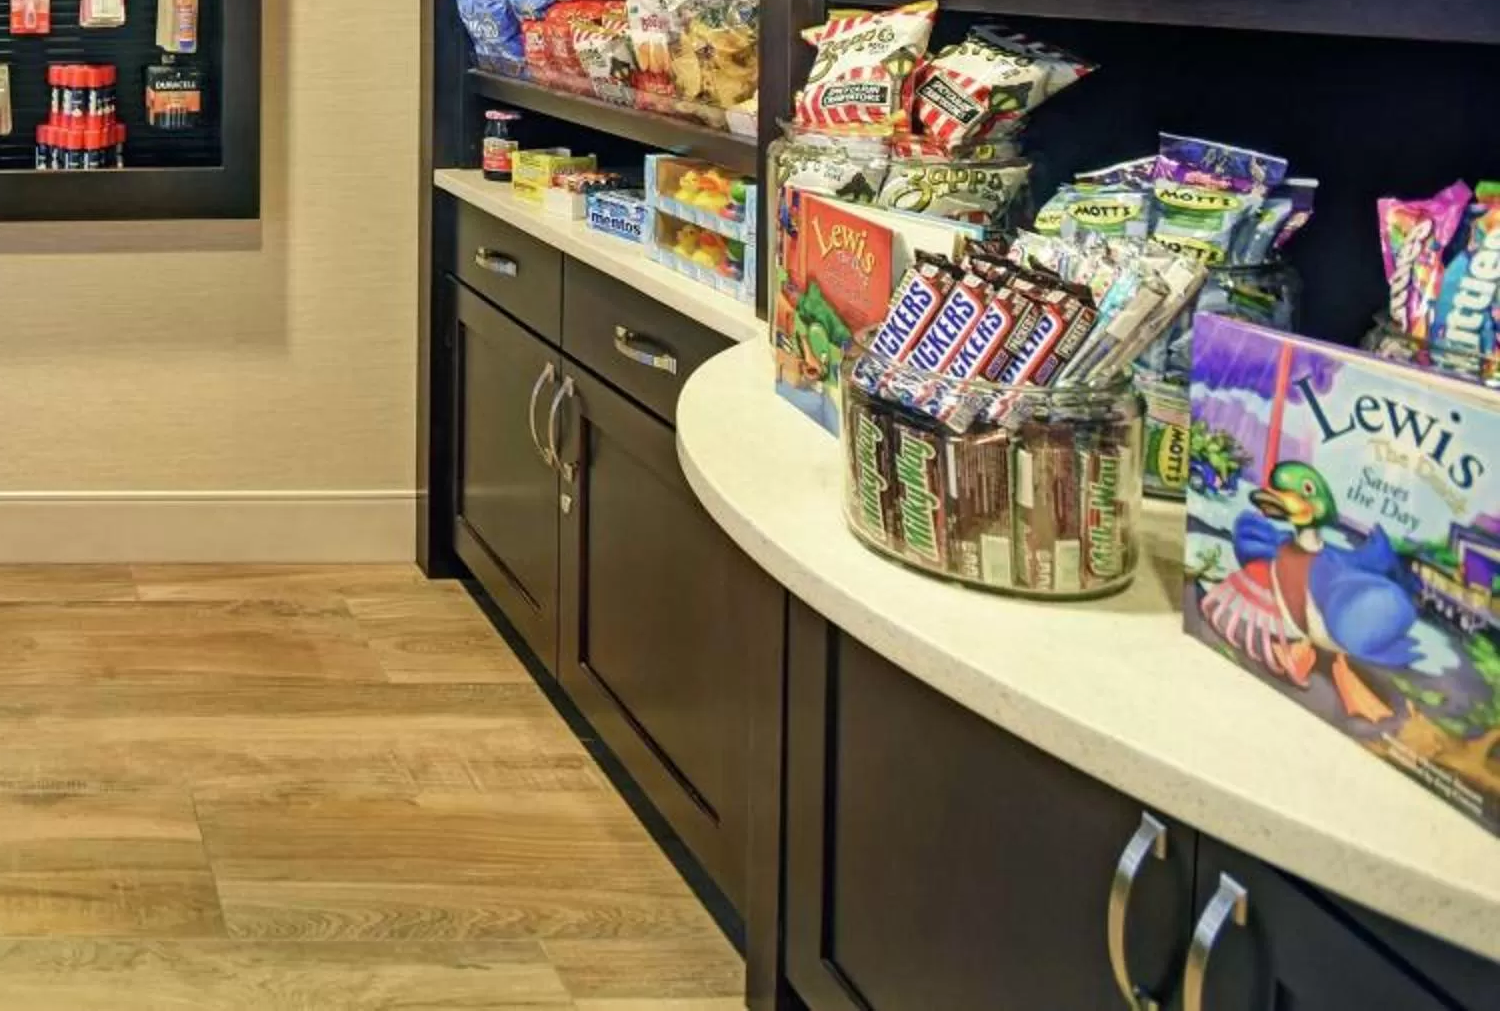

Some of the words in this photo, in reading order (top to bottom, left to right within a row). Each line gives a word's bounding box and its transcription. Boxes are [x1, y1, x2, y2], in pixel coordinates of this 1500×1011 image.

[155, 80, 196, 90] DURACELL
[591, 212, 641, 236] mentos
[812, 217, 876, 275] Lewis
[1293, 375, 1485, 490] Lewis
[1346, 479, 1376, 509] the
[1379, 496, 1422, 532] Day
[1362, 466, 1410, 502] Saves
[900, 483, 941, 561] Milky
